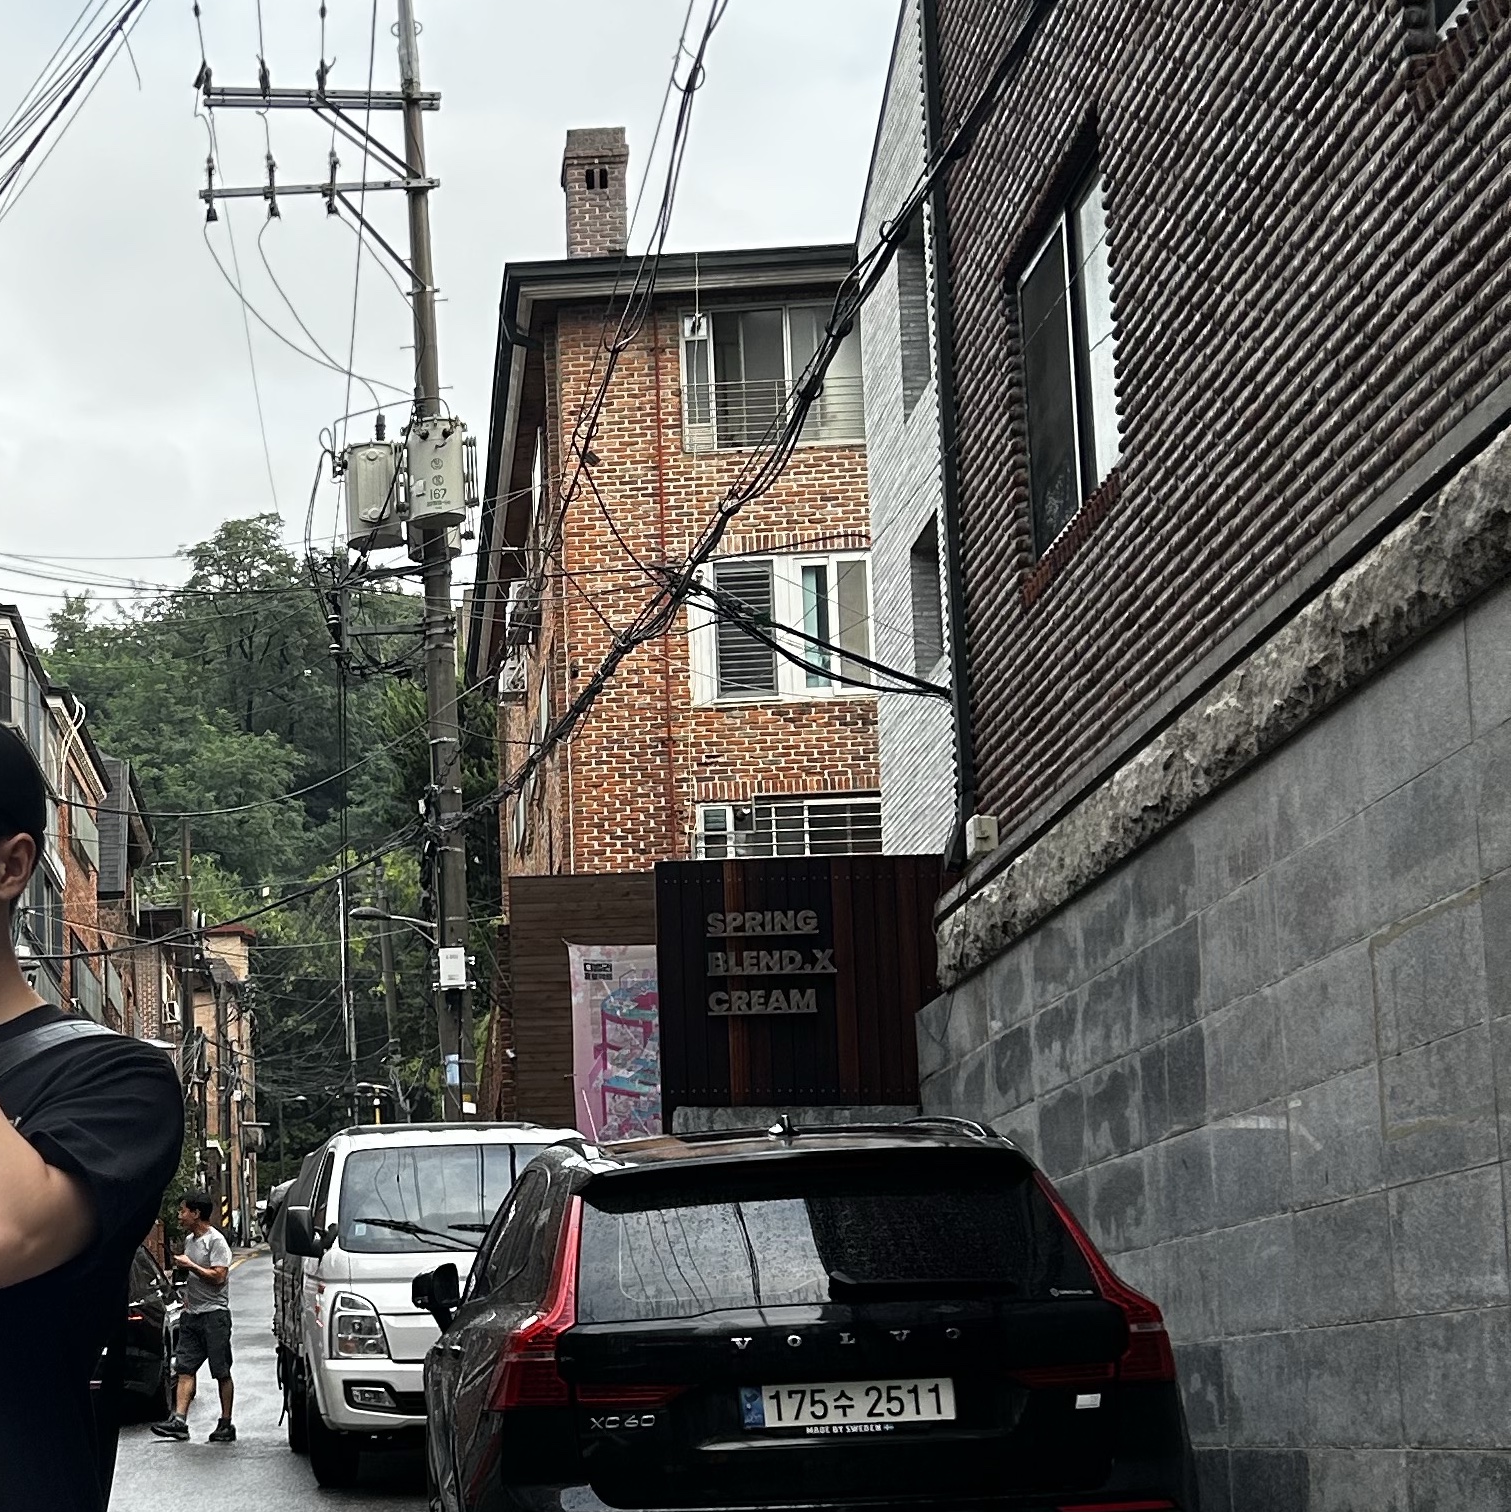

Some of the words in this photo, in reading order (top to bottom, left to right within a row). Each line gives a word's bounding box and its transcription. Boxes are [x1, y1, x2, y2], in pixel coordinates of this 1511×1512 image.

[430, 488, 447, 500] 167
[707, 910, 818, 934] SPRING
[708, 989, 817, 1013] CREAM
[731, 1328, 961, 1349] VOLVO
[769, 1389, 855, 1421] 175수
[865, 1383, 943, 1417] 2511
[806, 1426, 830, 1434] MADE
[832, 1425, 844, 1433] BY
[845, 1424, 882, 1433] SWEDEN
